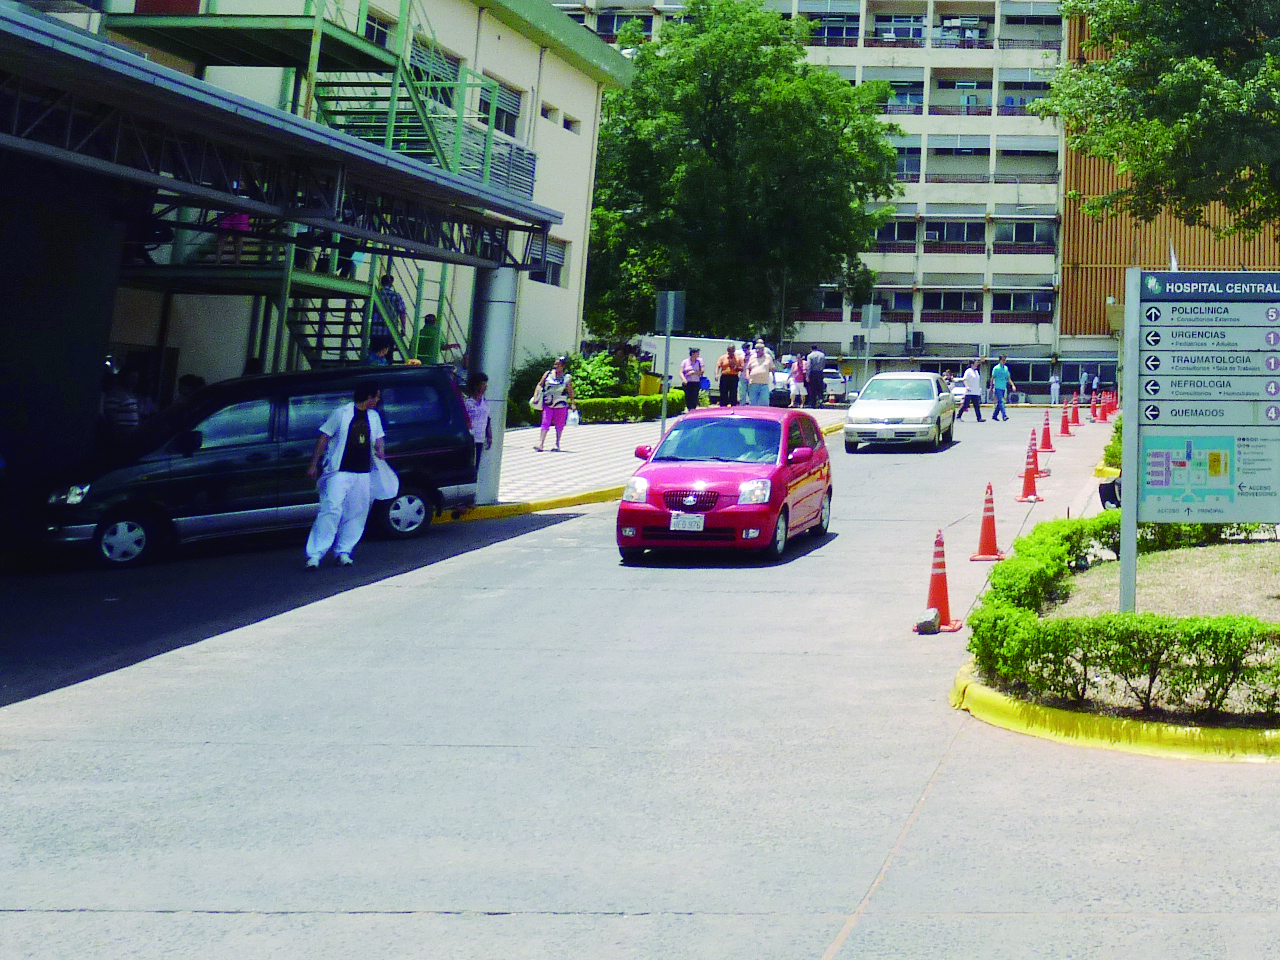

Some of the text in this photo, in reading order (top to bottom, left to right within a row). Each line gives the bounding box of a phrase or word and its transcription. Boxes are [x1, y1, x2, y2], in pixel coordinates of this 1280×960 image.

[1166, 283, 1280, 293] HOSPITAL CENTRAL
[1268, 309, 1276, 320] 5
[1171, 331, 1226, 339] URGENCIAS
[1268, 333, 1275, 344] 1
[1171, 355, 1251, 364] TRAUMATOLOGIA
[1268, 358, 1275, 369] 1
[1267, 383, 1275, 394] 4
[1170, 409, 1225, 418] QUEMADOS
[1268, 408, 1276, 419] 4
